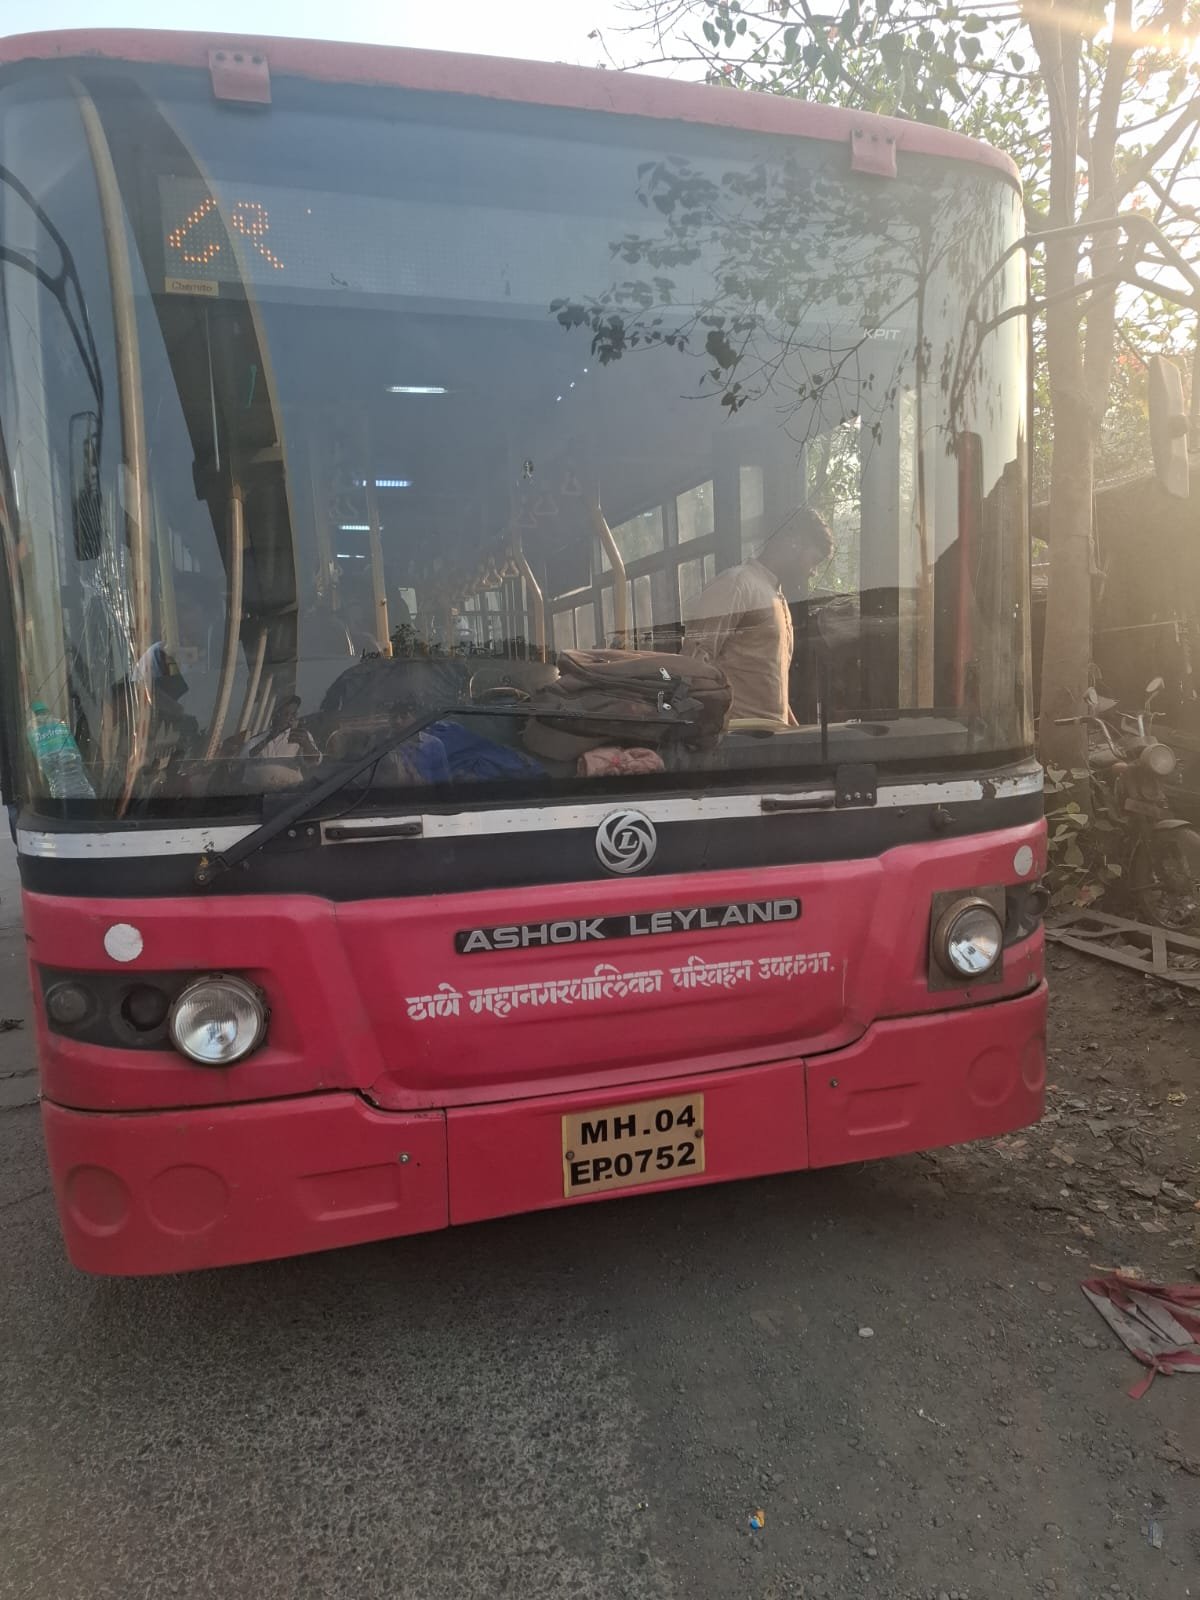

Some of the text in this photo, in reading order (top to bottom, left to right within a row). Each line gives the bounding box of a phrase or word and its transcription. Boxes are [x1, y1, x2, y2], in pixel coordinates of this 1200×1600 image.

[863, 328, 901, 340] KPIT
[462, 899, 799, 953] ASHOK LEYLAND
[405, 982, 464, 1021] ठाणे
[467, 963, 664, 1018] महानगरपालिका
[670, 955, 755, 992] परिवहन
[580, 1105, 696, 1146] MH.04
[570, 1141, 697, 1187] EP.0752
